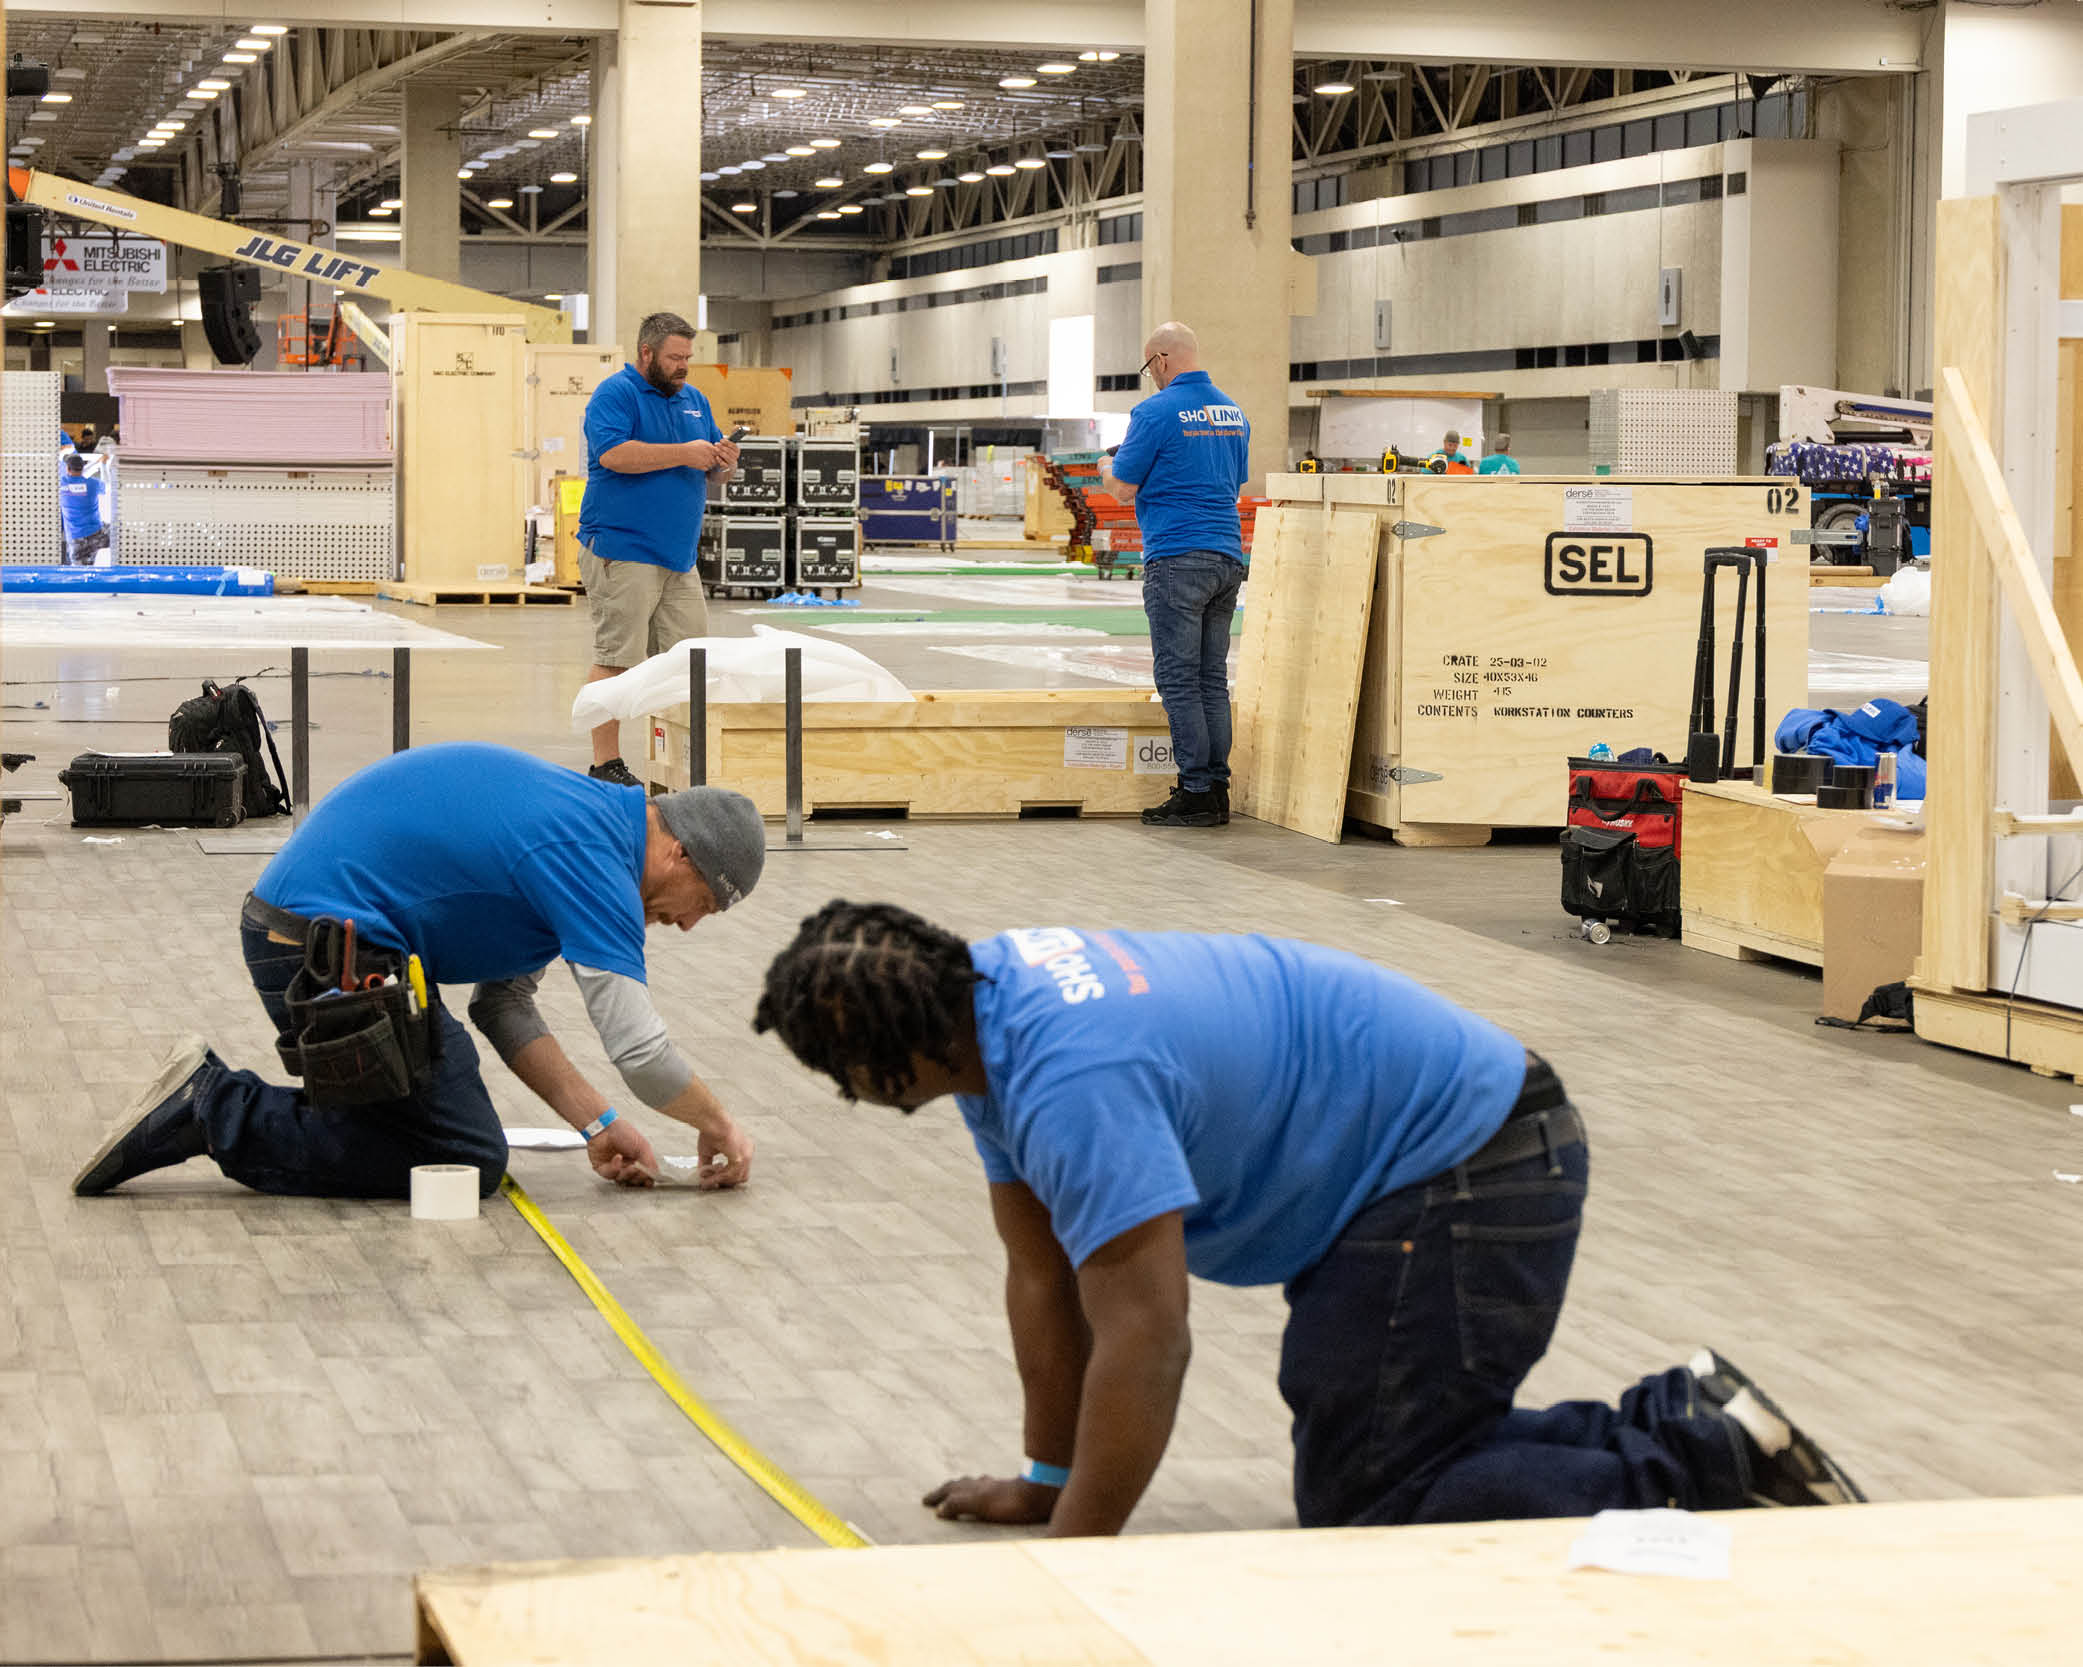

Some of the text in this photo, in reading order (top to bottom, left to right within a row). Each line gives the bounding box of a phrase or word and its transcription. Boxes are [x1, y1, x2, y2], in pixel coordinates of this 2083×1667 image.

[83, 246, 161, 260] MITSUBISHI
[83, 260, 151, 273] ELECTRIC
[235, 236, 381, 287] JLG LIFT
[1178, 408, 1241, 423] SHO LINK
[1387, 478, 1396, 504] 02
[1766, 487, 1800, 514] 02
[1559, 544, 1640, 583] SEL
[1443, 655, 1547, 668] CRATE 25-03-02
[1453, 672, 1479, 684] SIZE
[1433, 689, 1479, 701] WEIGHT
[1417, 704, 1634, 719] CONTENTS WORKSTATION COUNTERS
[1044, 954, 1104, 1005] SHO
